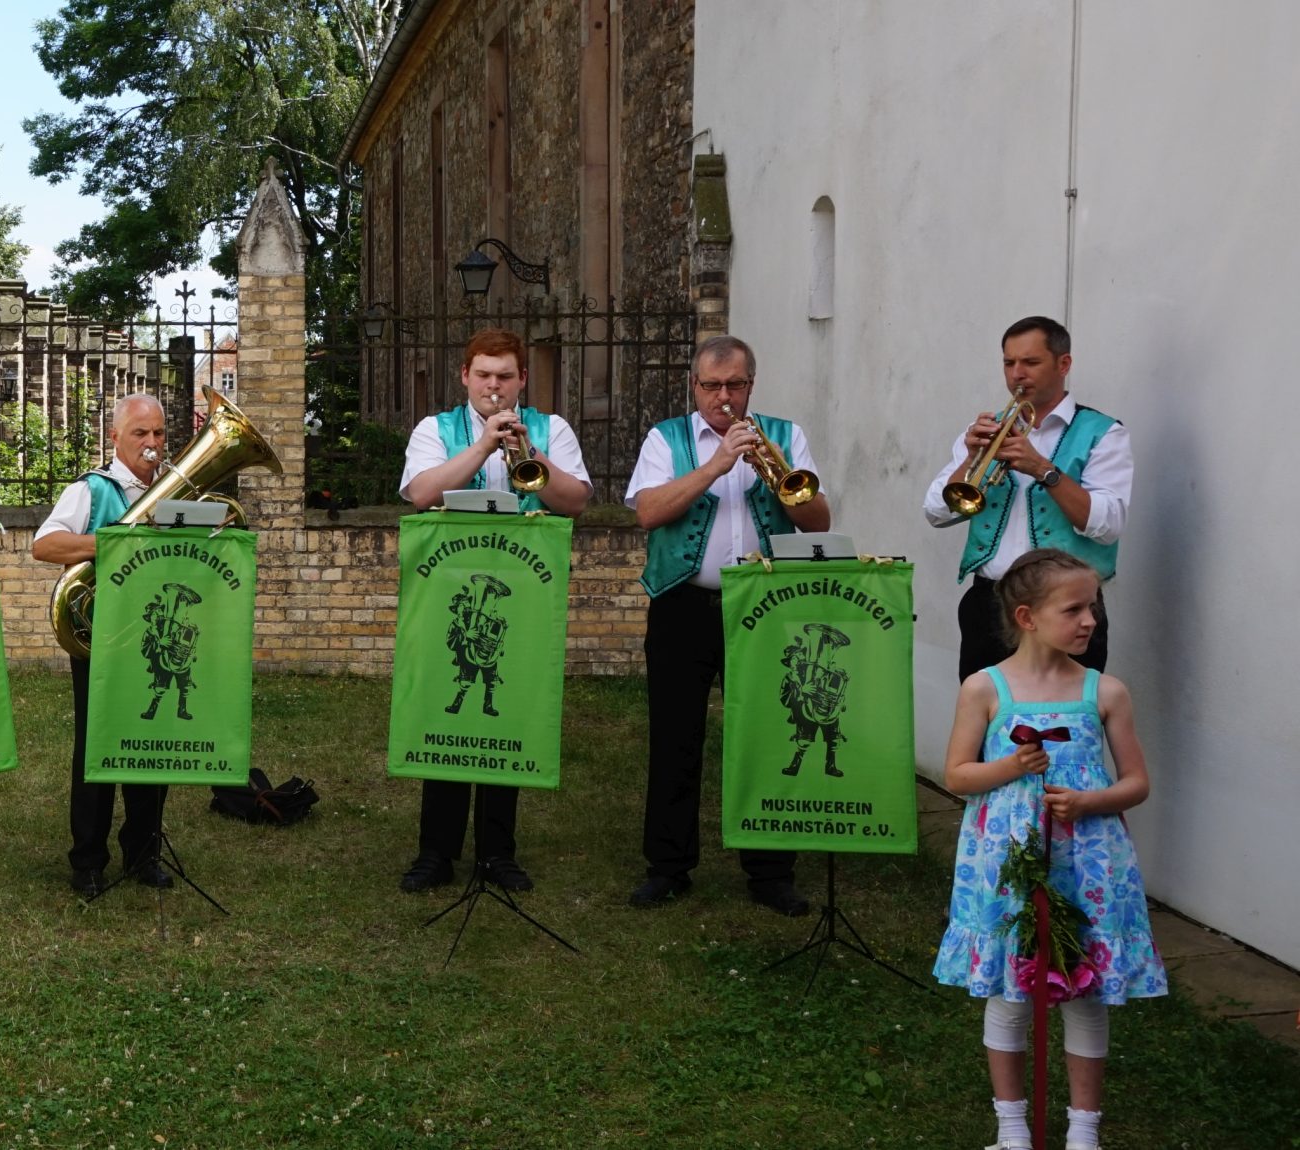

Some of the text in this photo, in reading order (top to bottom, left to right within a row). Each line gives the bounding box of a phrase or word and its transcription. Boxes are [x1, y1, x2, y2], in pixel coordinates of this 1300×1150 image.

[109, 541, 242, 591] Dorfmusikanten
[416, 532, 554, 584] Dorfmusikanten
[741, 578, 895, 631] Dorfmusikanten
[120, 739, 215, 752] MUSIKVEREIN
[424, 733, 522, 752] MUSIKVEREIN
[101, 756, 201, 771] ALTRANSTÄDT
[405, 751, 507, 770] ALTRANSTÄDT
[761, 798, 873, 816] MUSIKVEREIN
[741, 818, 857, 835] ALTRANSTÄDT
